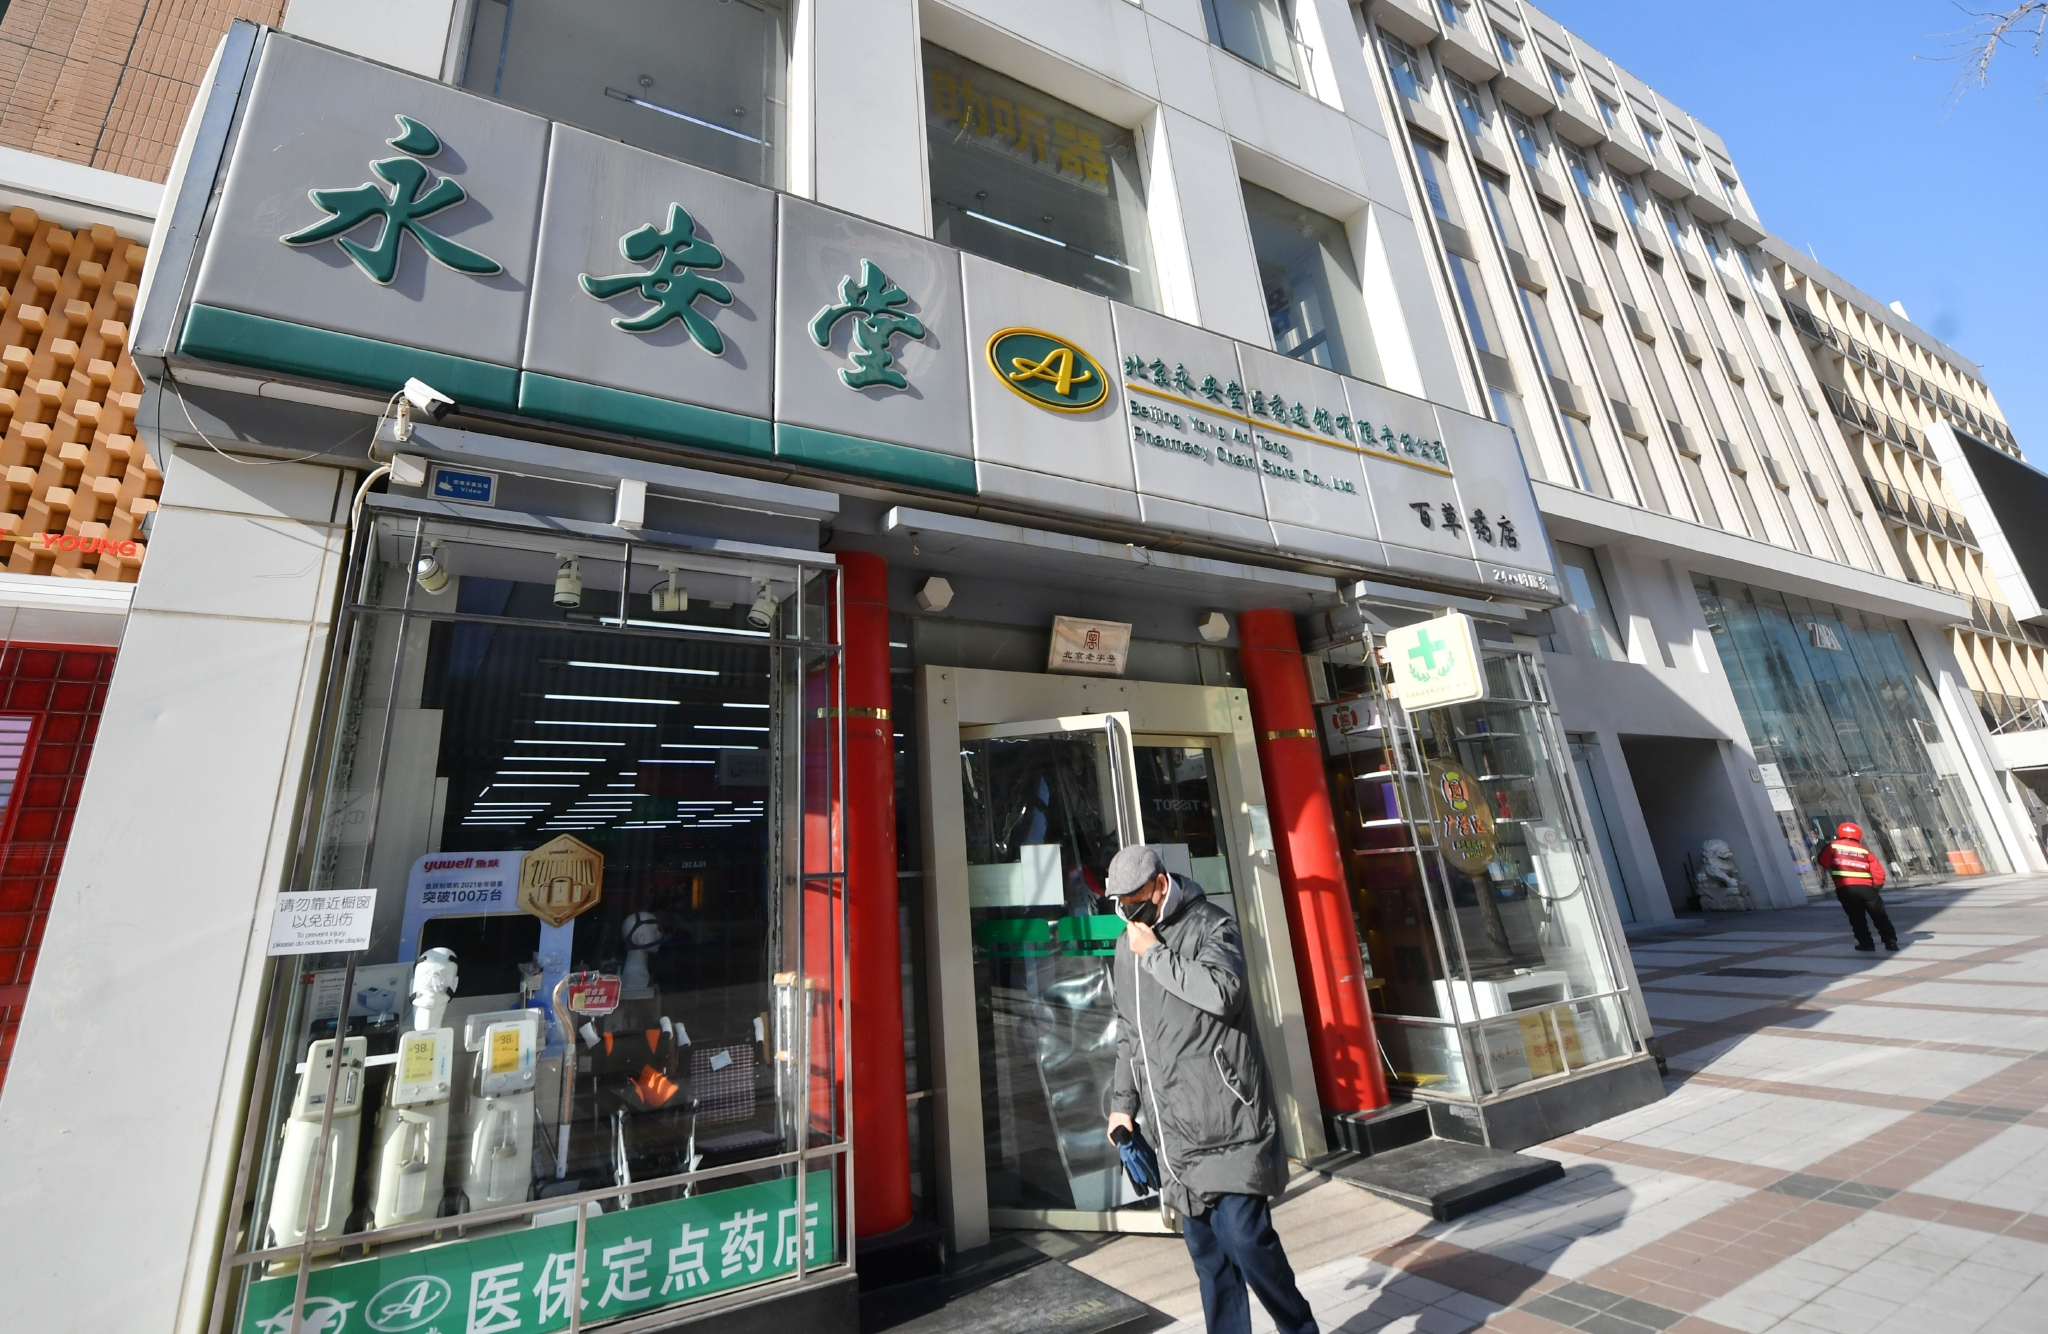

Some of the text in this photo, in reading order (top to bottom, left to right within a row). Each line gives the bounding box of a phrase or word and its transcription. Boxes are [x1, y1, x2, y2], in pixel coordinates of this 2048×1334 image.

[930, 68, 1109, 185] 助听器
[279, 113, 927, 393] 永安堂
[1123, 353, 1448, 465] 北京永安堂医药连锁有限责任公司
[1129, 399, 1289, 458] Beijing Yong An Tang
[1132, 425, 1208, 460] Pharmacy
[1215, 446, 1256, 469] Chain
[1260, 459, 1297, 480] Store
[1330, 475, 1357, 494] Ltd.
[460, 486, 482, 494] Video
[1408, 502, 1518, 548] 百草药店
[42, 532, 137, 557] YOUNG
[1062, 650, 1116, 662] 北京老字号
[424, 858, 500, 873] yuwell 鱼跃
[461, 880, 503, 889] 2021全年销量
[279, 895, 371, 913] 请勿靠近橱窗
[422, 889, 503, 904] 突破100万台
[291, 912, 354, 929] 以免刮伤
[305, 931, 329, 939] prevent
[316, 938, 334, 946] touch
[500, 1034, 512, 1044] 98
[413, 1043, 427, 1054] 98
[466, 1201, 819, 1334] 医保定点药店
